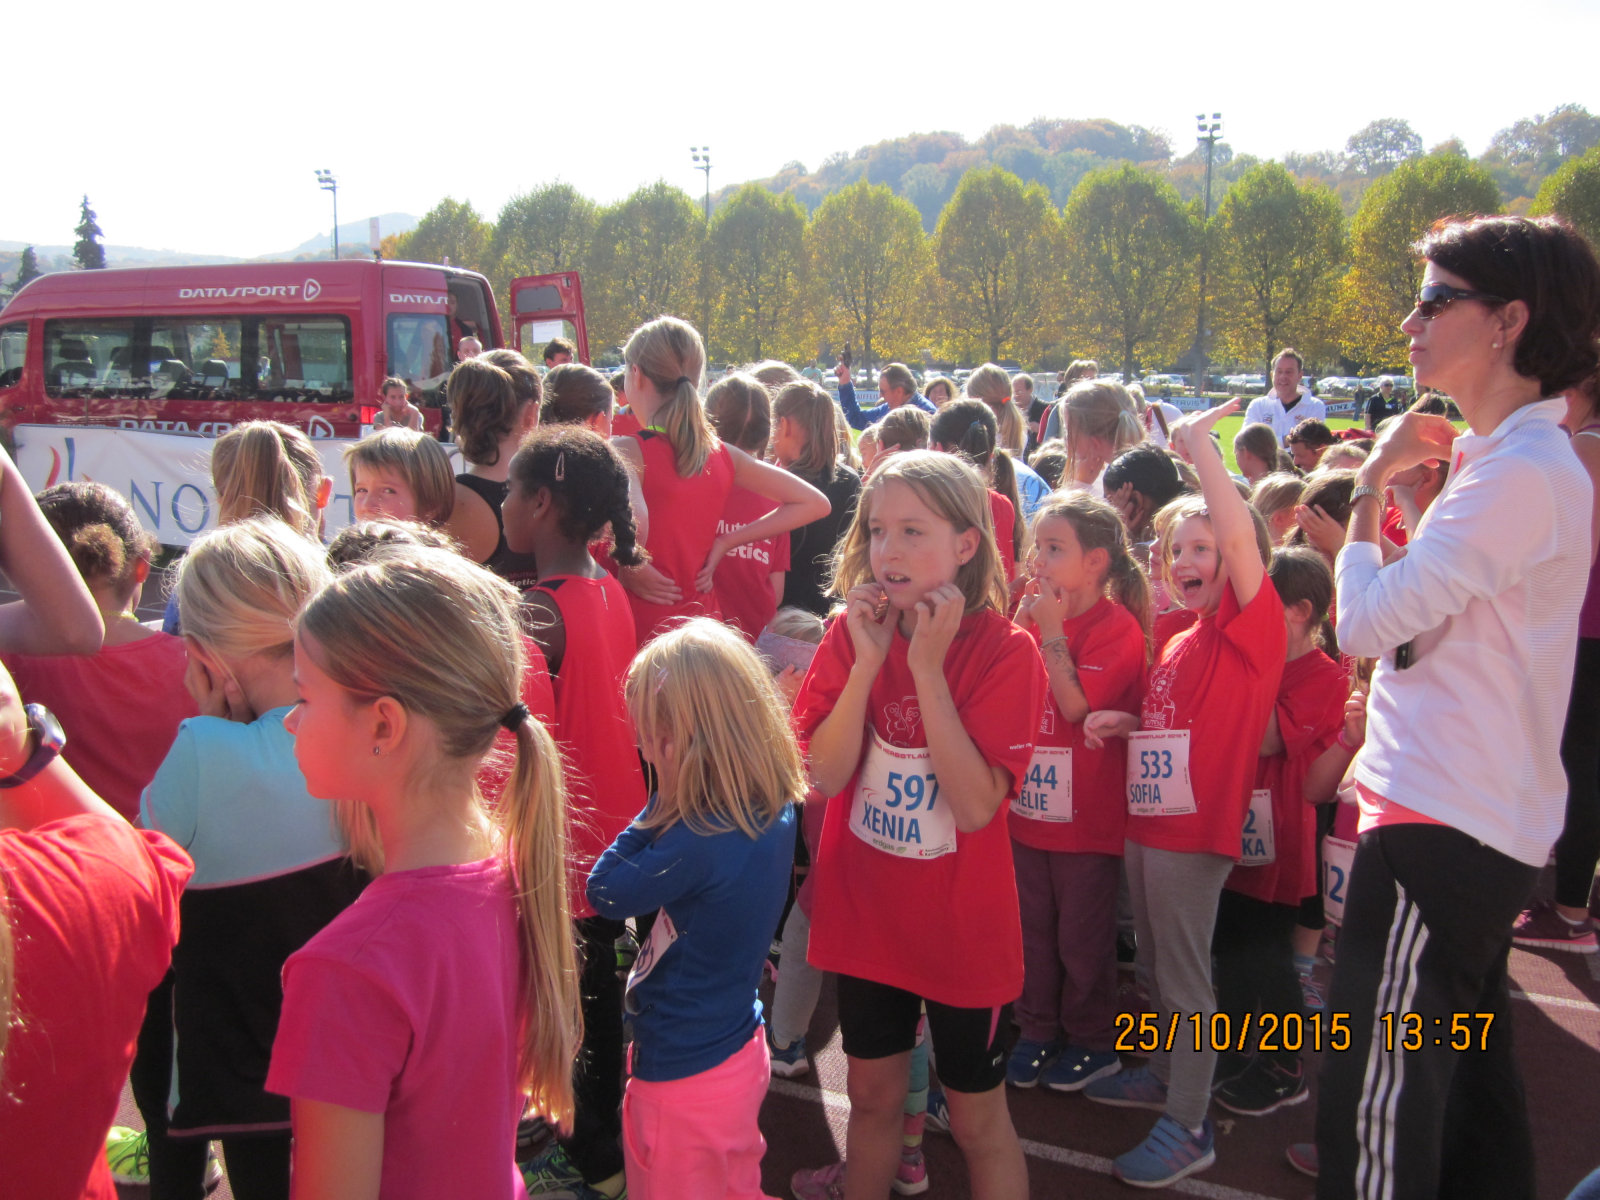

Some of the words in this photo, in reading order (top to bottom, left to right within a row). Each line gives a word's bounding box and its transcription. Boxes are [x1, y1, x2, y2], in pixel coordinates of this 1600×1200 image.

[179, 285, 300, 298] DATASPORT
[1140, 749, 1173, 779] 533
[885, 771, 939, 812] 597
[1130, 783, 1162, 804] SOFIA
[862, 800, 922, 844] XENIA
[1243, 808, 1257, 834] 2
[1242, 838, 1266, 856] KA
